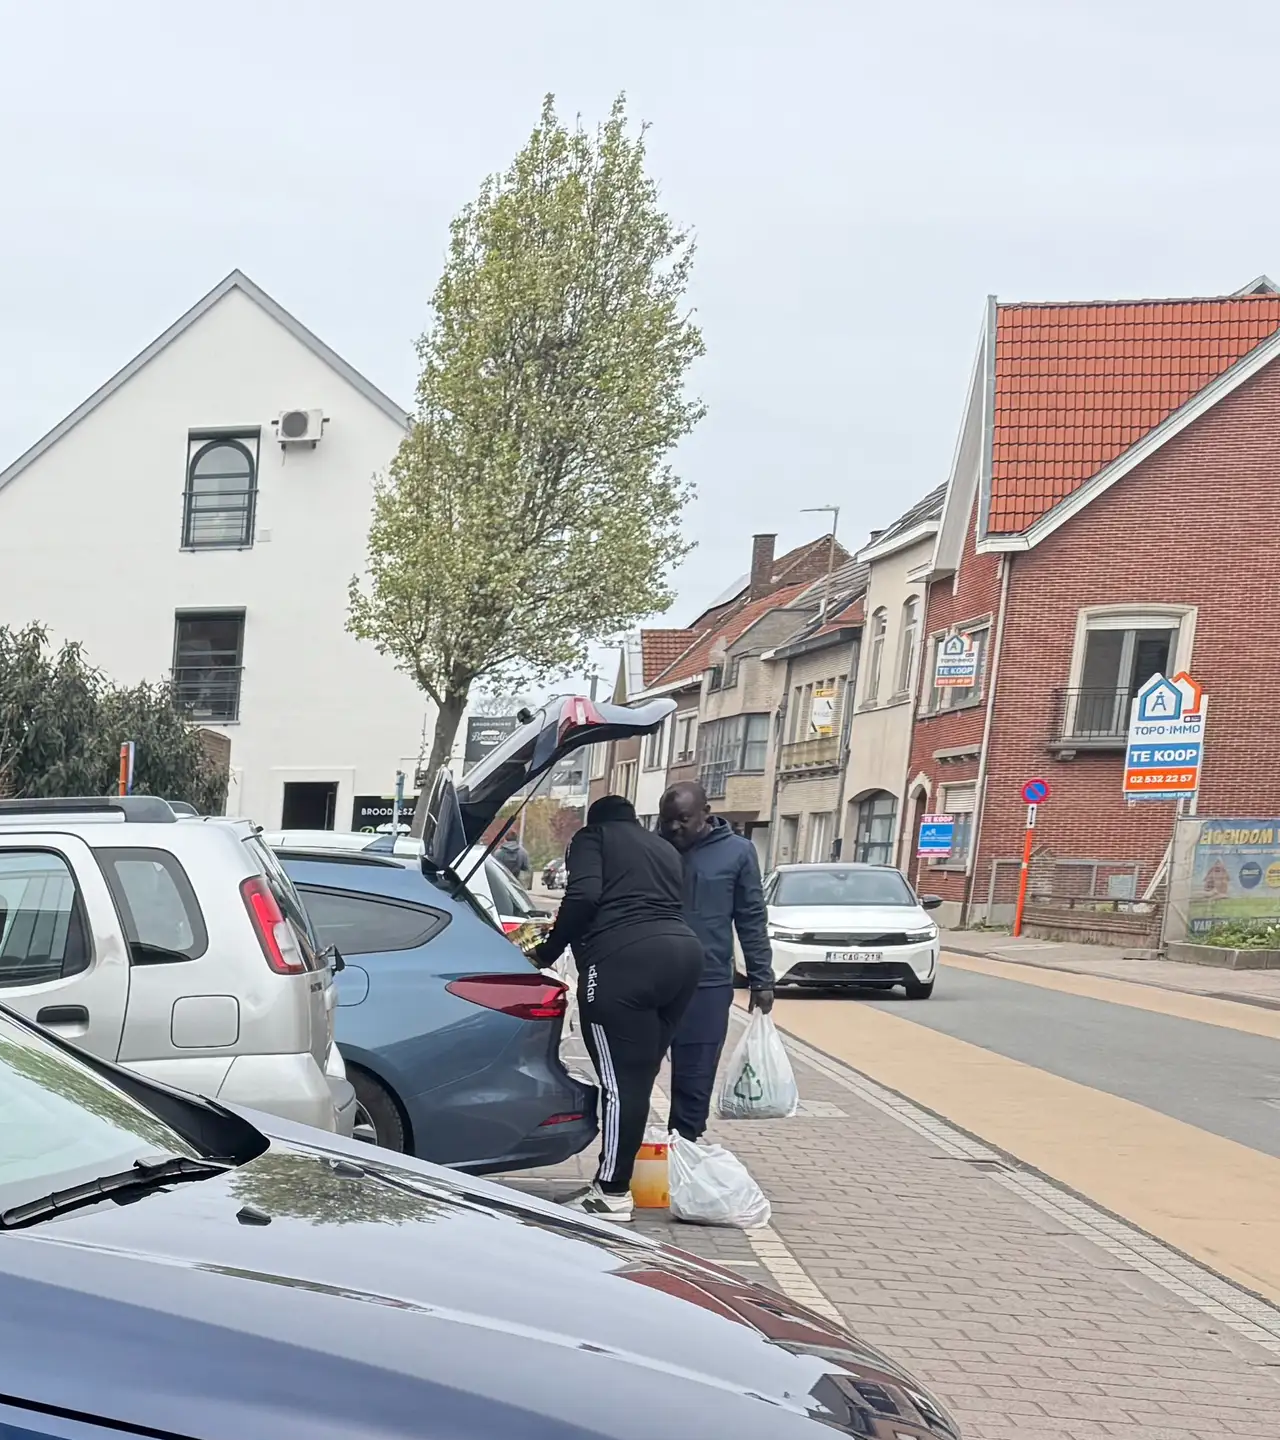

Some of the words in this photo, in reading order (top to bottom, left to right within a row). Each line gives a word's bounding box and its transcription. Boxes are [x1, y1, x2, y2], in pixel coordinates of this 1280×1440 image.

[1131, 750, 1151, 762] TE
[1154, 749, 1197, 761] KOOP
[1130, 775, 1143, 783] 02
[1165, 774, 1179, 782] 22
[1200, 828, 1274, 845] EIGENDOM
